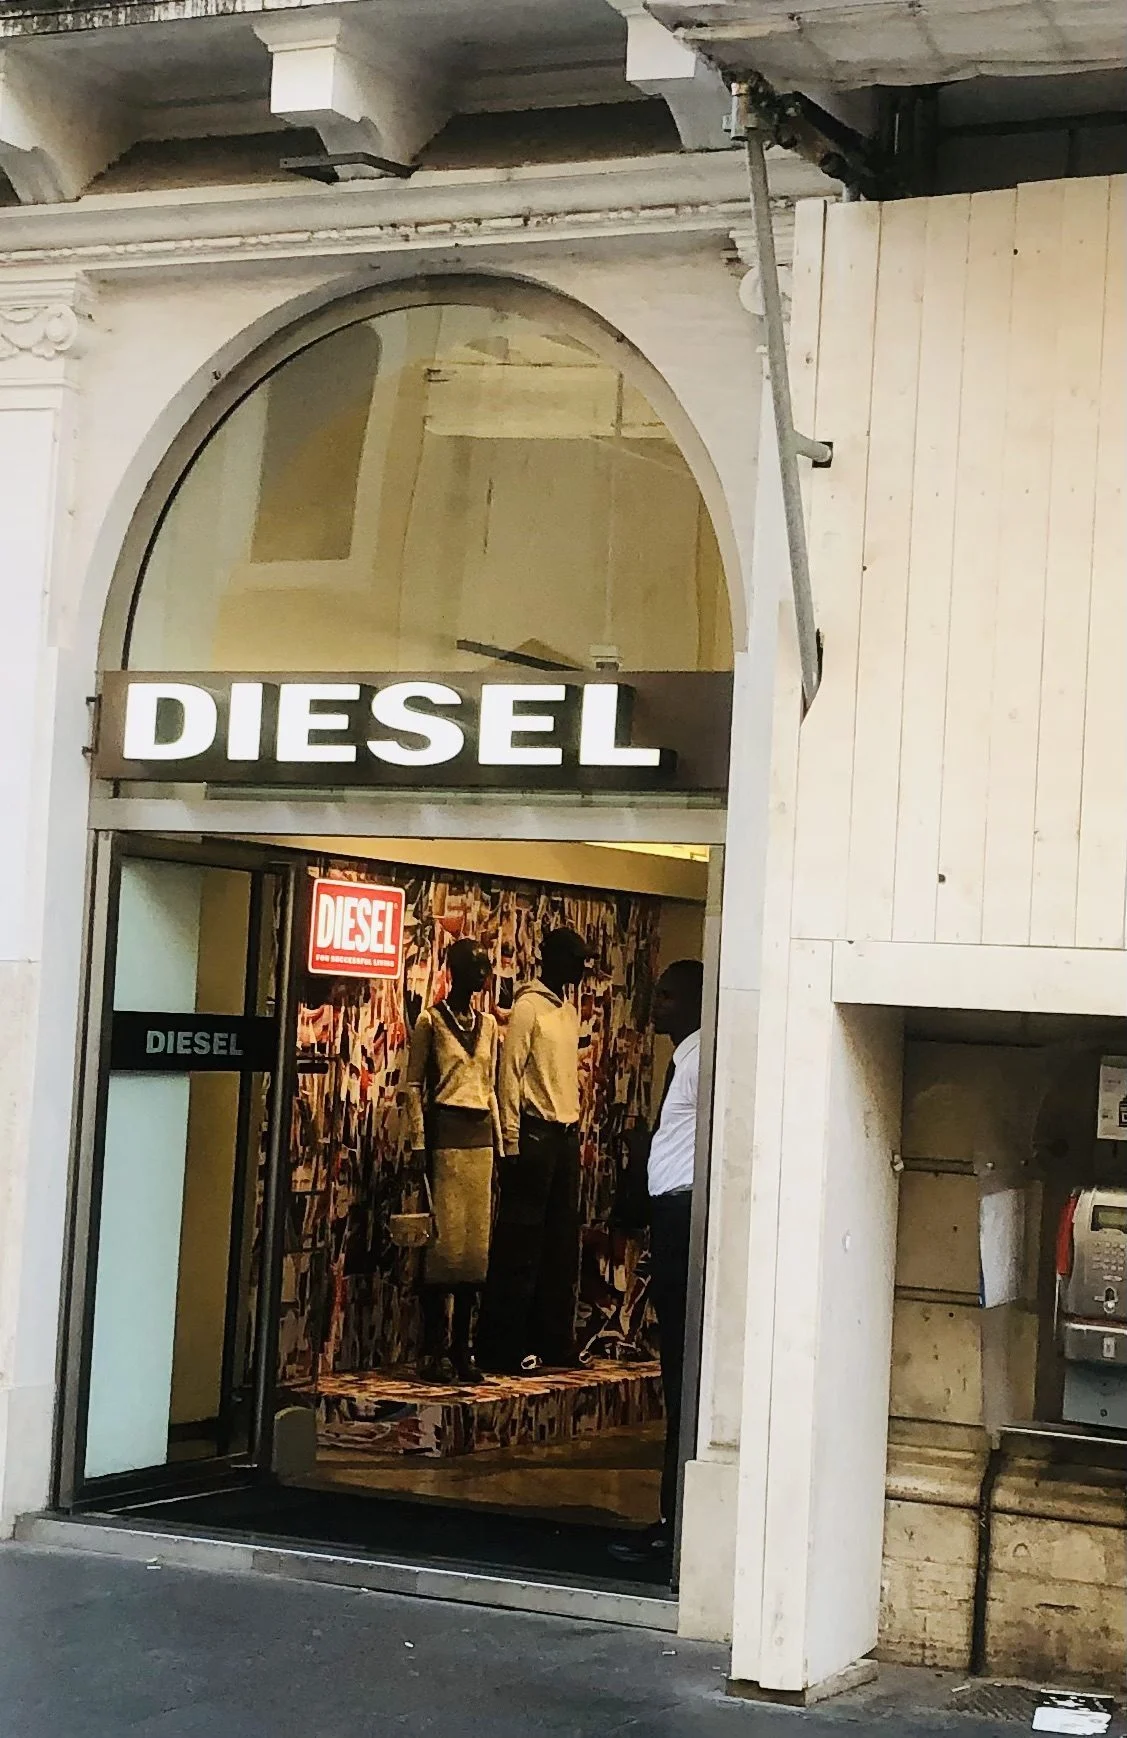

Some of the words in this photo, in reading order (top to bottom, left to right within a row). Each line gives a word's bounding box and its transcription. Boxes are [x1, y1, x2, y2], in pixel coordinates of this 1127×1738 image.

[123, 682, 661, 767] DIESEL
[317, 894, 395, 954] DIESEL
[316, 954, 330, 962] FOR
[373, 959, 394, 967] LIVING
[146, 1030, 243, 1056] DIESEL
